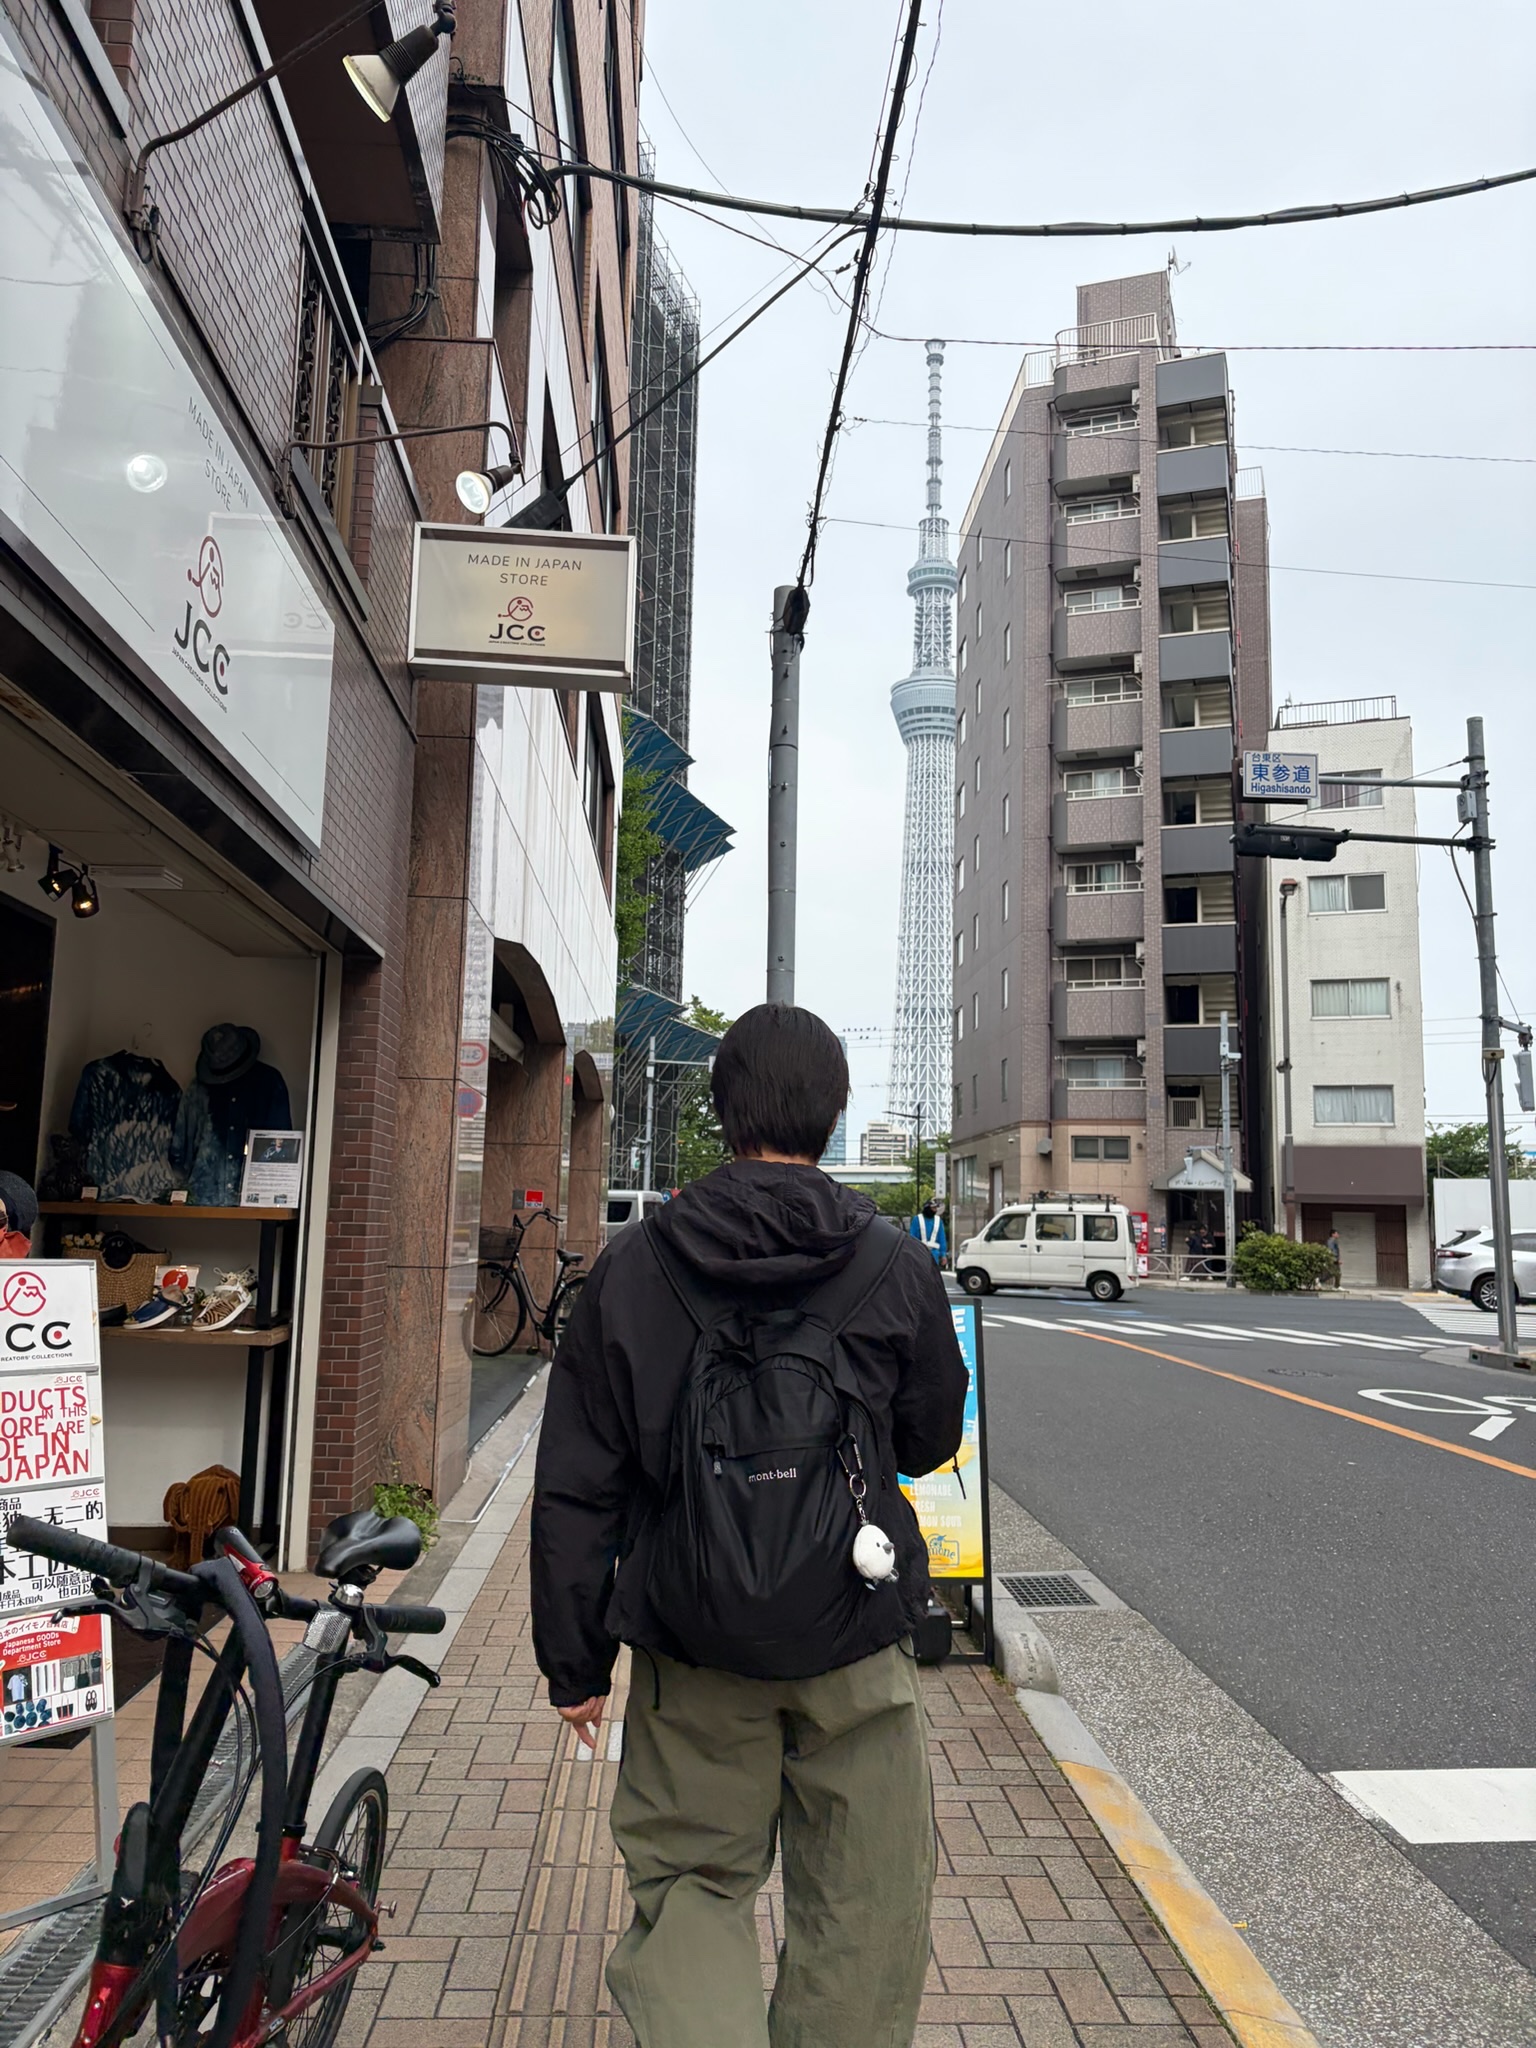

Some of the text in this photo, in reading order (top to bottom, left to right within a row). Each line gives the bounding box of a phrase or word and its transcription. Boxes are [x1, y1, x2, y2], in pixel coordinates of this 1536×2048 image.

[188, 396, 249, 508] MADE IN JAPAN
[205, 459, 231, 511] STORE
[467, 554, 582, 570] MADE IN JAPAN
[500, 573, 548, 586] STORE
[489, 623, 546, 642] JCC
[174, 600, 231, 695] JCC
[1252, 753, 1281, 763] 台東区
[1251, 763, 1311, 783] 東参道
[1251, 782, 1311, 794] Higashisando
[31, 1352, 73, 1360] COLLECTIONS
[63, 1375, 83, 1383] JCC
[41, 1406, 88, 1420] IN THIS
[56, 1420, 85, 1434] ARE
[0, 1449, 89, 1483] JAPAN
[82, 1488, 100, 1497] JCC
[910, 1483, 952, 1496] LEMONADE
[4, 1632, 59, 1648] Japanese GOODs
[3, 1639, 61, 1656] Department Store
[27, 1650, 47, 1660] JCC
